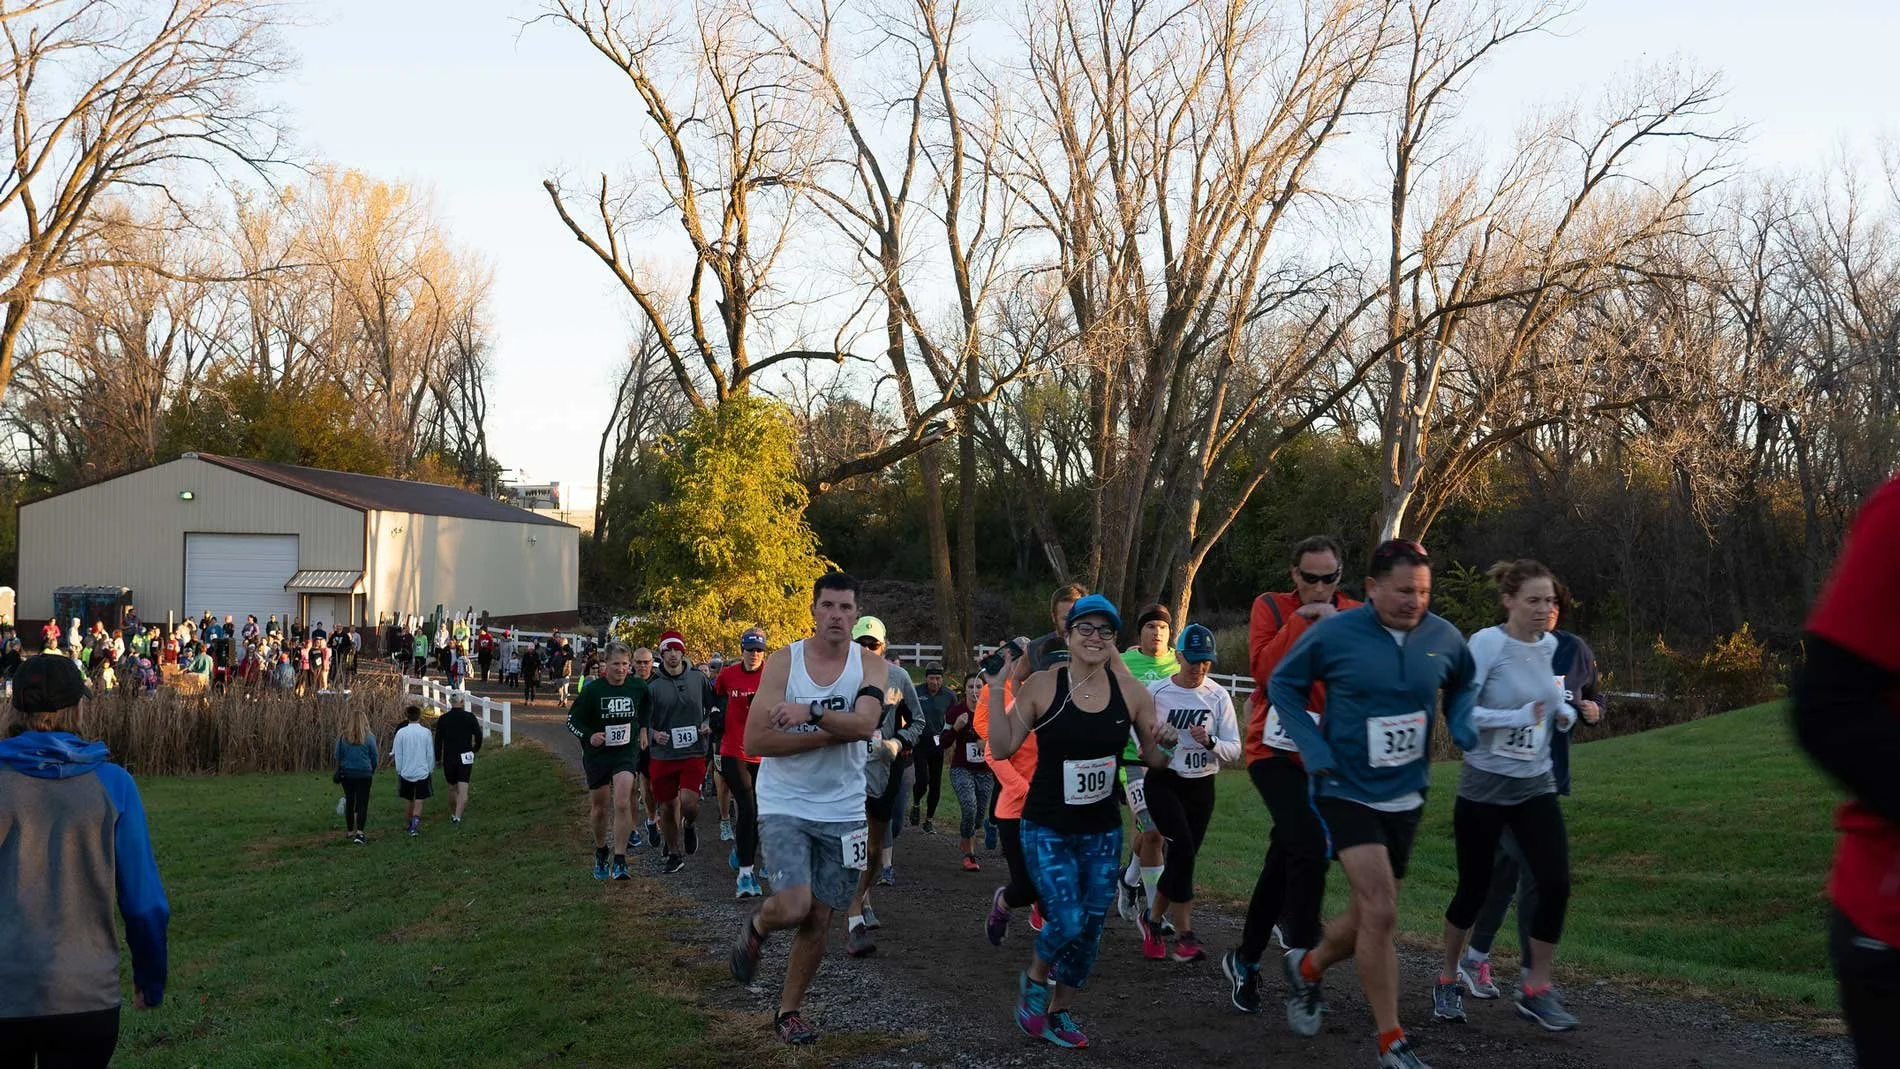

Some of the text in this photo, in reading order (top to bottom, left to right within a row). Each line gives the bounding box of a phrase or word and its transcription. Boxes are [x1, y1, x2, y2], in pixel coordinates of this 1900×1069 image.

[607, 698, 631, 712] 402
[1167, 709, 1211, 729] NIKE
[611, 730, 626, 741] 387
[677, 732, 693, 743] 343
[1384, 728, 1416, 754] 322
[1185, 752, 1207, 769] 406
[1077, 771, 1105, 793] 309
[1131, 788, 1145, 805] 33
[852, 841, 867, 863] 33
